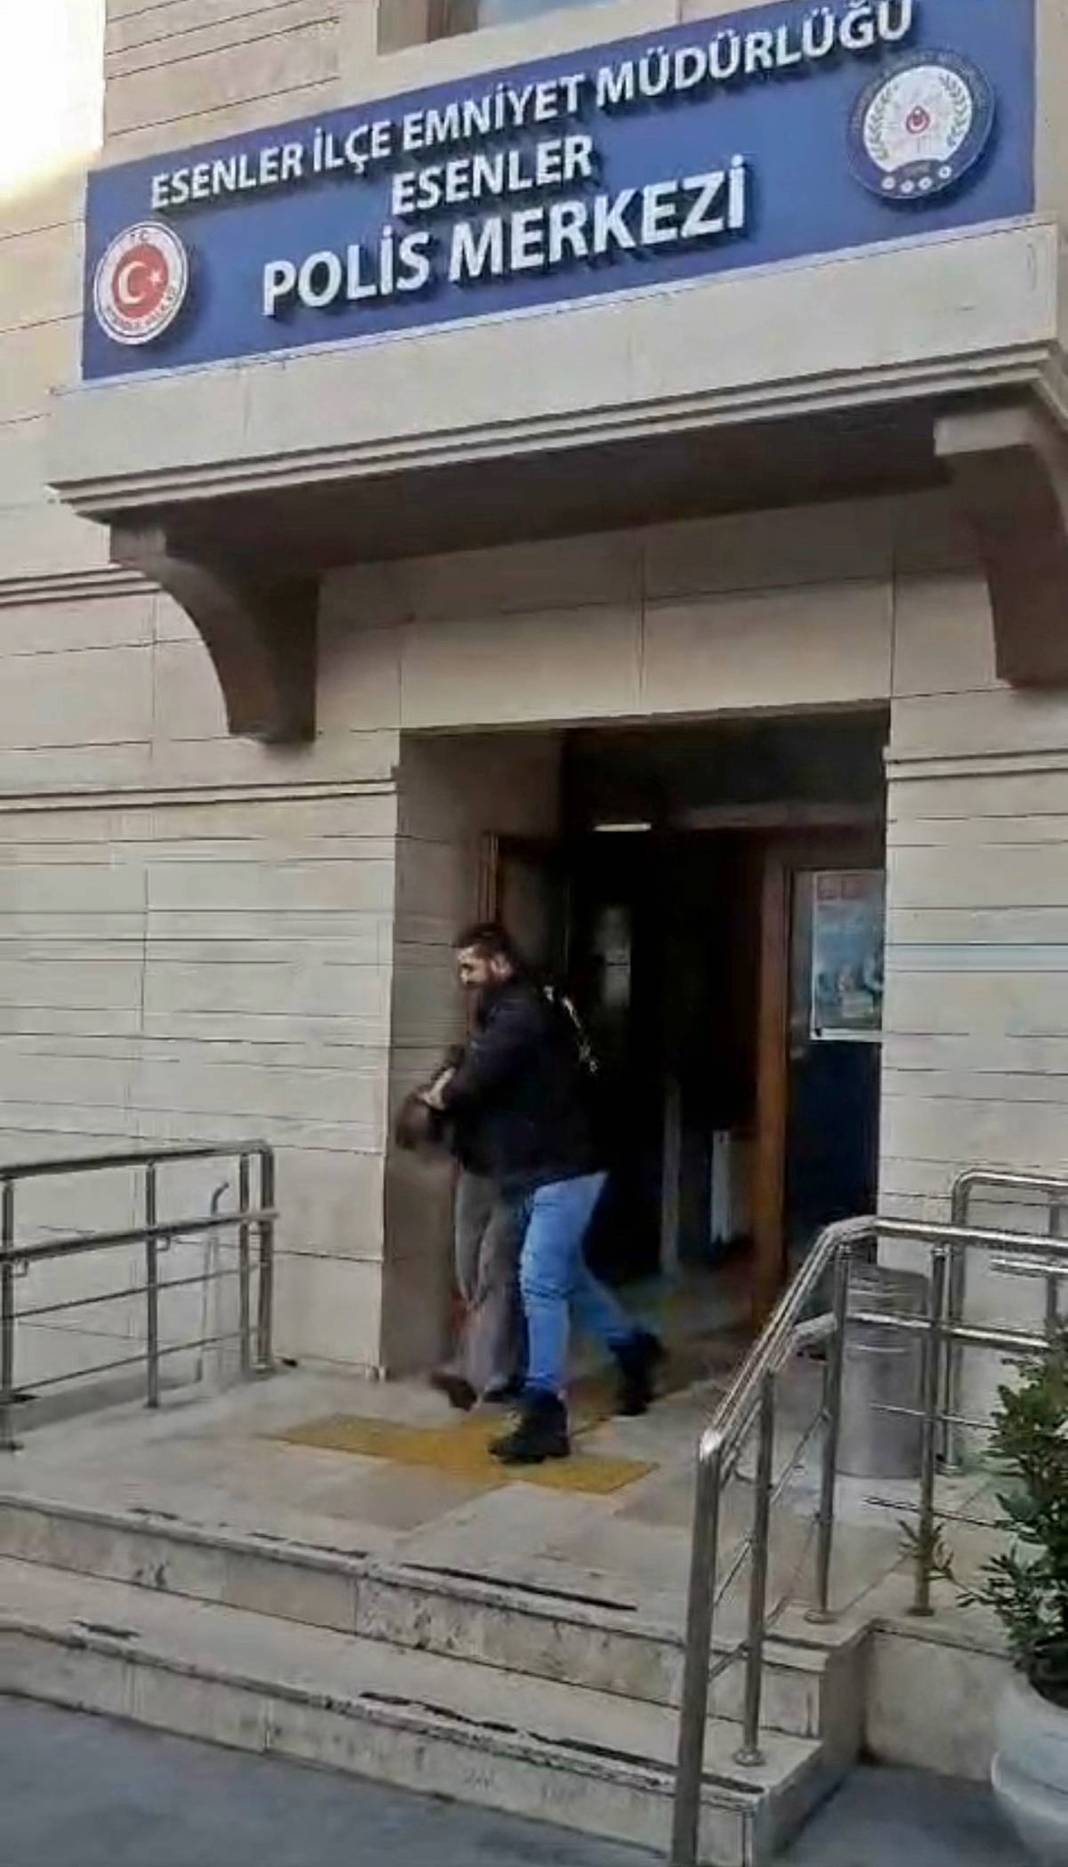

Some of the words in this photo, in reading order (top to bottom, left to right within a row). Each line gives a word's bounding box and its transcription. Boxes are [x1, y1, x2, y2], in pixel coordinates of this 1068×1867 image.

[151, 141, 304, 209] ESENLER
[312, 127, 391, 174] İLÇE
[402, 73, 585, 153] EMNİYET
[391, 134, 593, 216] ESENLER
[262, 225, 431, 316] POLİS
[448, 154, 746, 282] MERKEZİ
